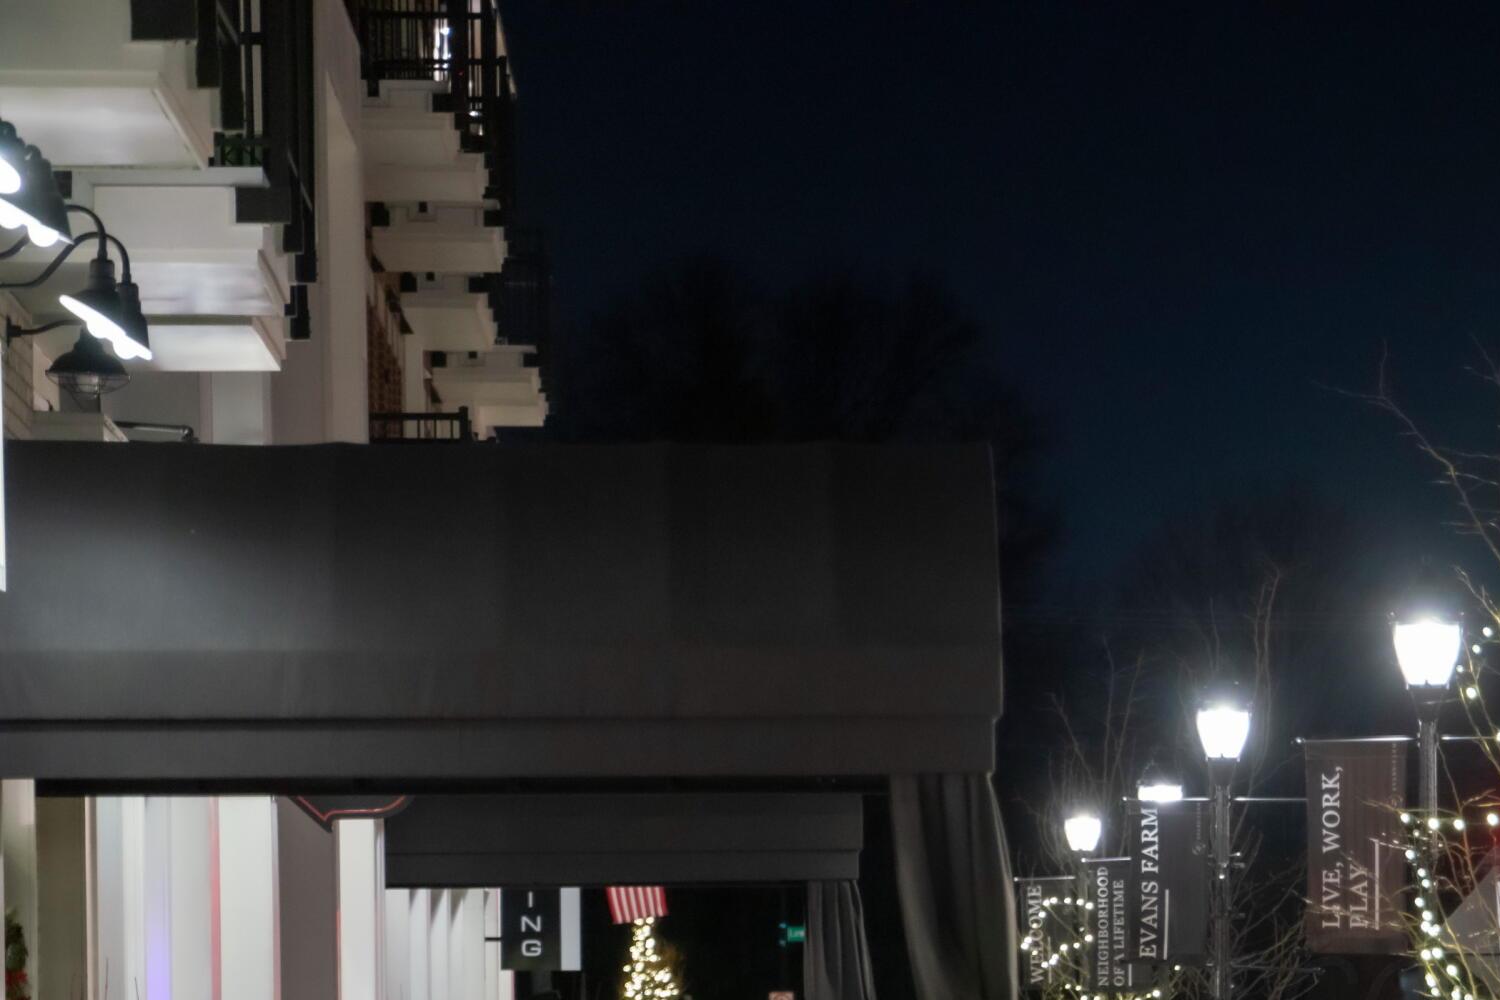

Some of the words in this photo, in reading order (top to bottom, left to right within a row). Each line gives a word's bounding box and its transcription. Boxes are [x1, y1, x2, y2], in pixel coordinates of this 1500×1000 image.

[1141, 807, 1159, 874] FARM
[1321, 765, 1344, 854] WORK,
[1097, 866, 1109, 987] NEIGHBORHOOD
[1112, 879, 1124, 948] LIFETIME
[1139, 881, 1158, 959] EVANS
[1322, 862, 1344, 929] LIVE,
[1350, 861, 1368, 929] PLAY
[1027, 885, 1044, 984] WELCOME
[1113, 968, 1125, 987] OF
